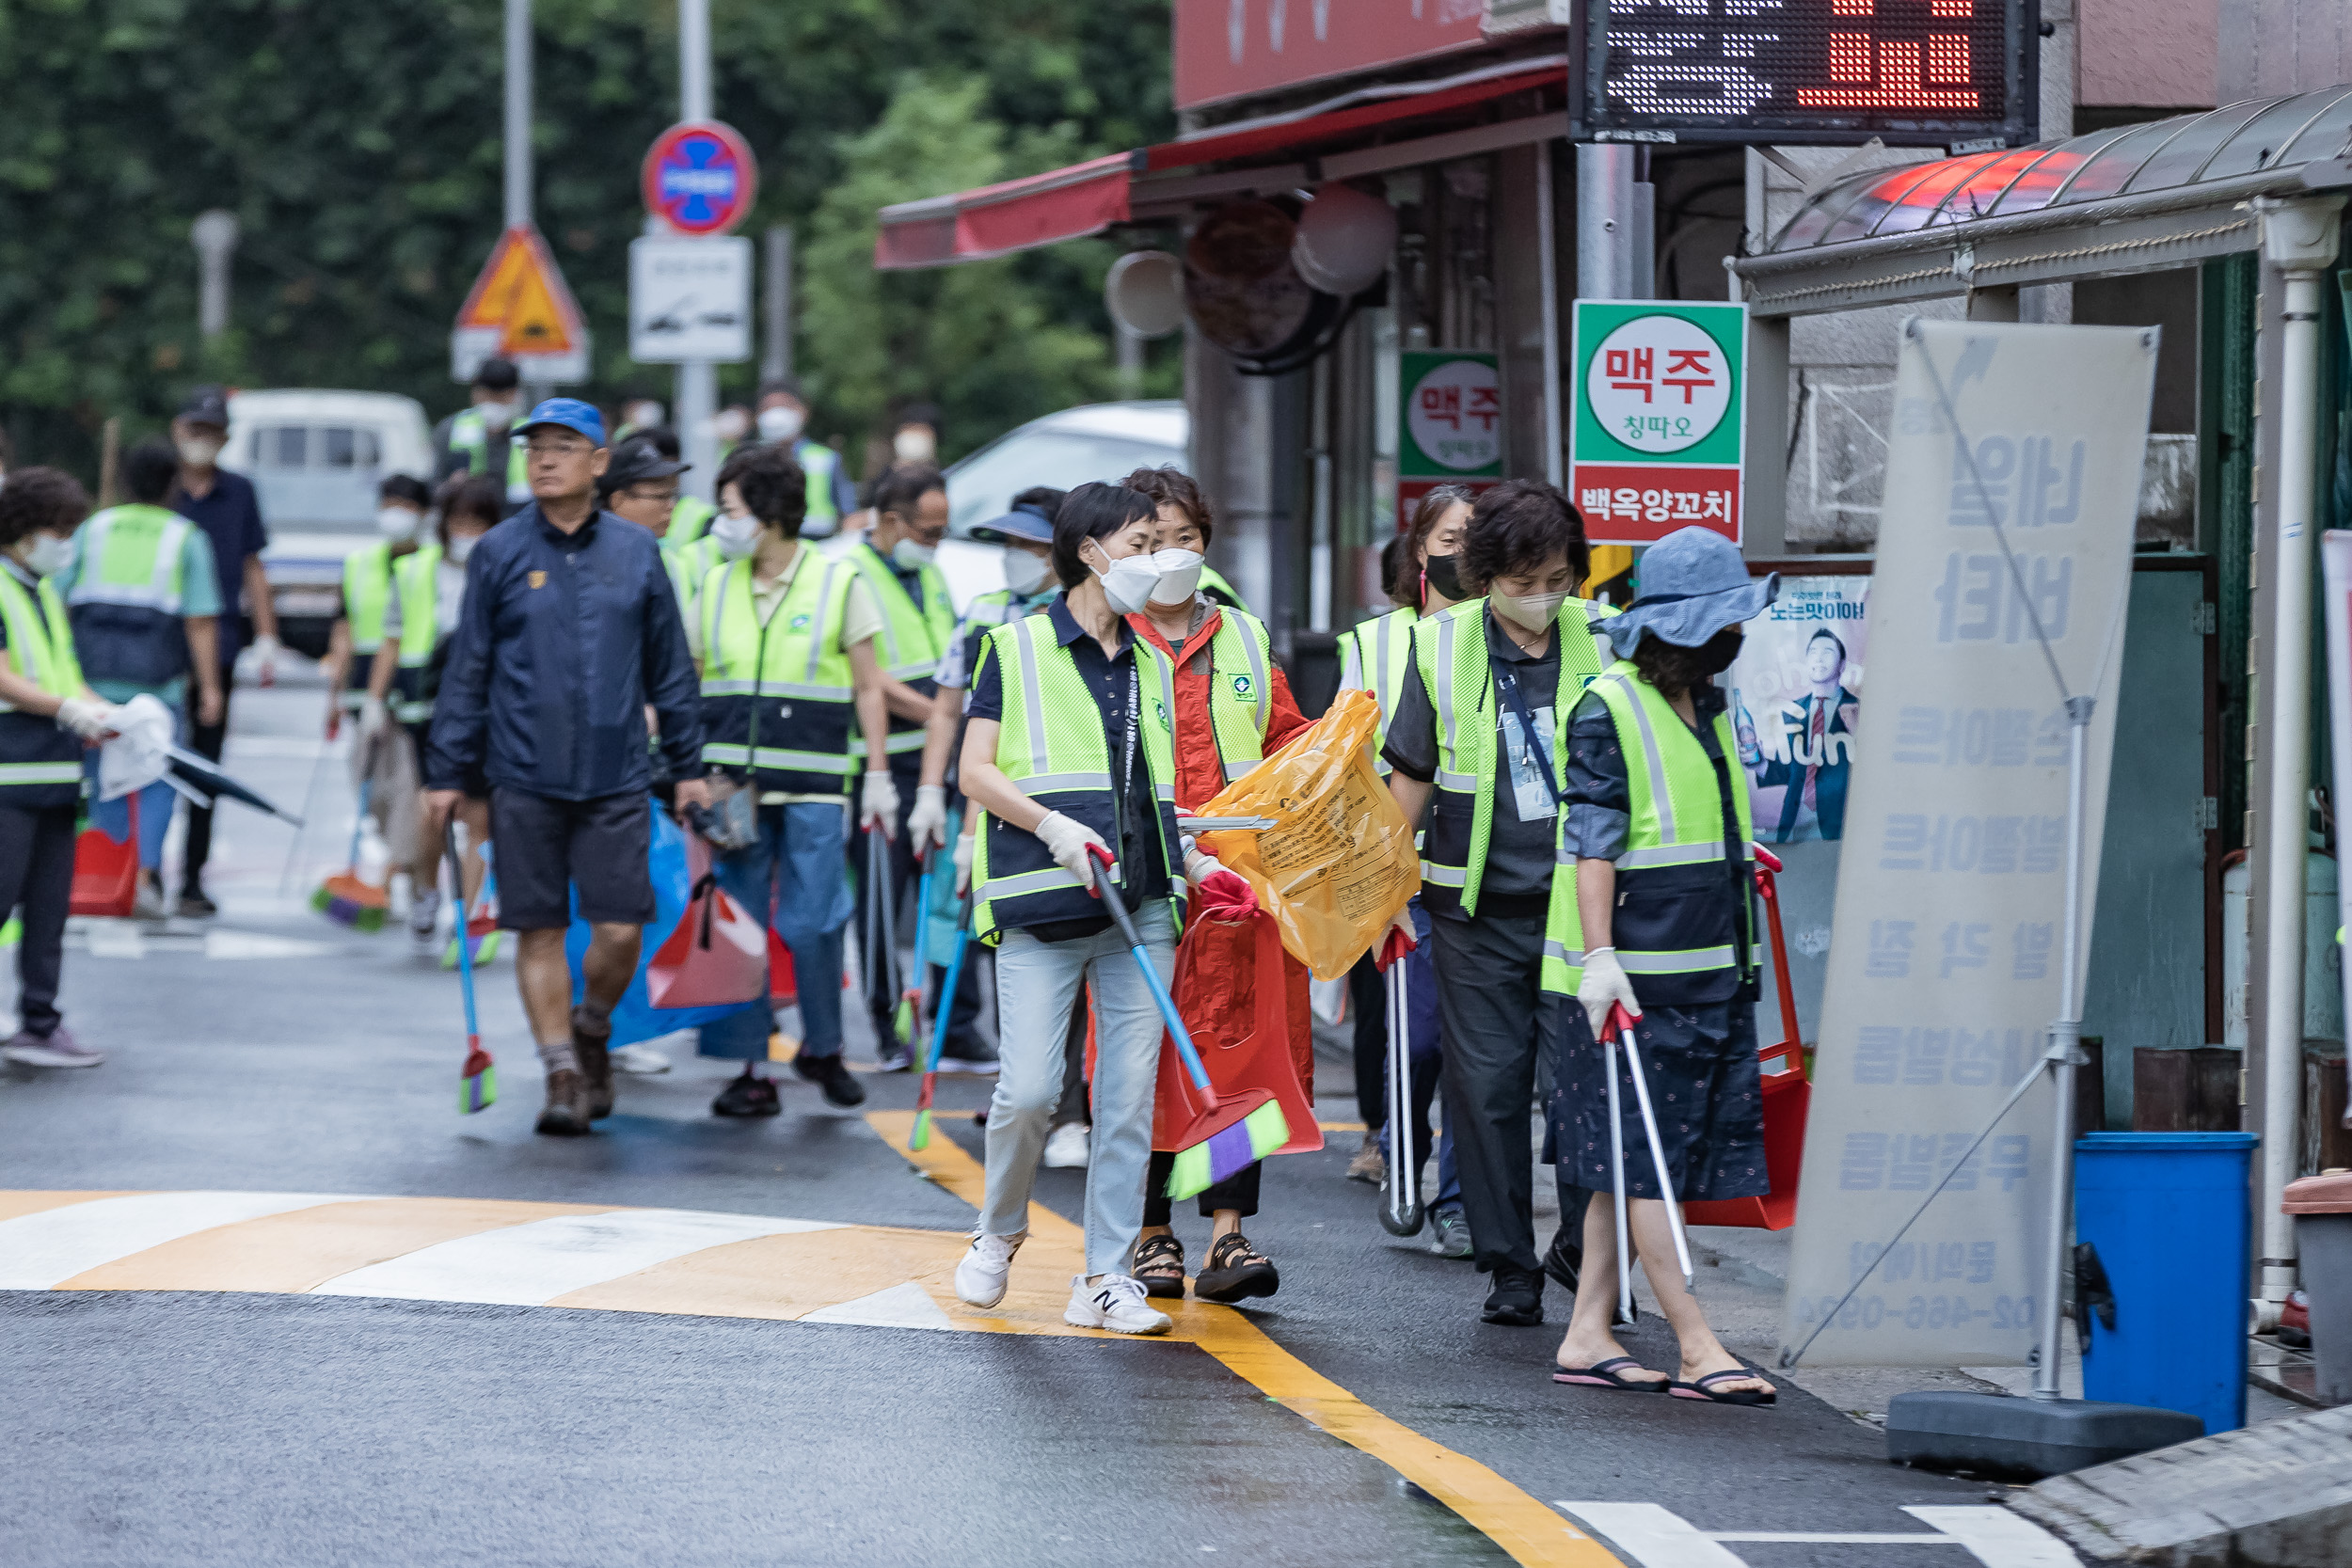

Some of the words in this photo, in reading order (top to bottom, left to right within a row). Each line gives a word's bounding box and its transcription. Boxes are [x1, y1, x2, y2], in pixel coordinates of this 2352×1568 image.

[1606, 347, 1715, 404] 맥주
[1422, 386, 1499, 431] 맥주
[1623, 415, 1694, 440] 칭따오
[1581, 487, 1731, 523] 백옥양꼬치
[1770, 601, 1865, 621] 노는맛이야!
